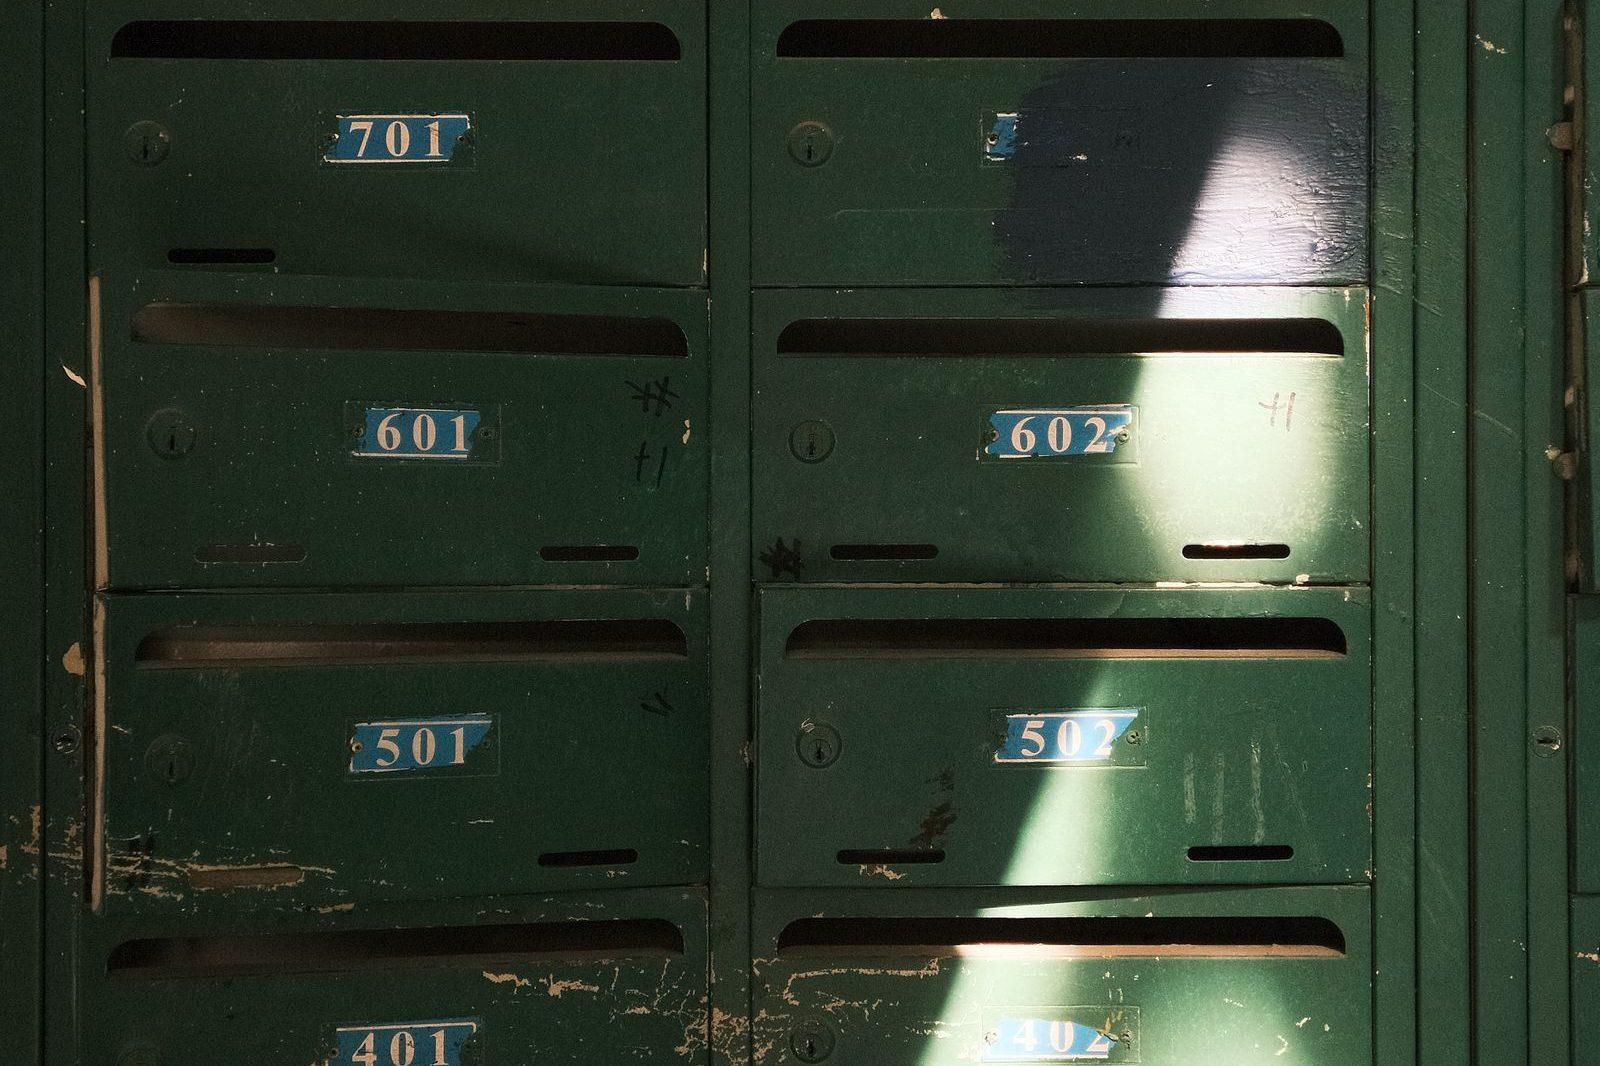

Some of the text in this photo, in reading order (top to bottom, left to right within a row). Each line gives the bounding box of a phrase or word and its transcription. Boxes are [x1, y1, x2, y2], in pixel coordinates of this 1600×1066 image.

[349, 121, 442, 156] 701
[376, 414, 469, 451] 601
[1011, 416, 1106, 452] 602
[376, 726, 465, 765] 501
[1020, 720, 1113, 757] 502
[352, 1030, 449, 1066] 401
